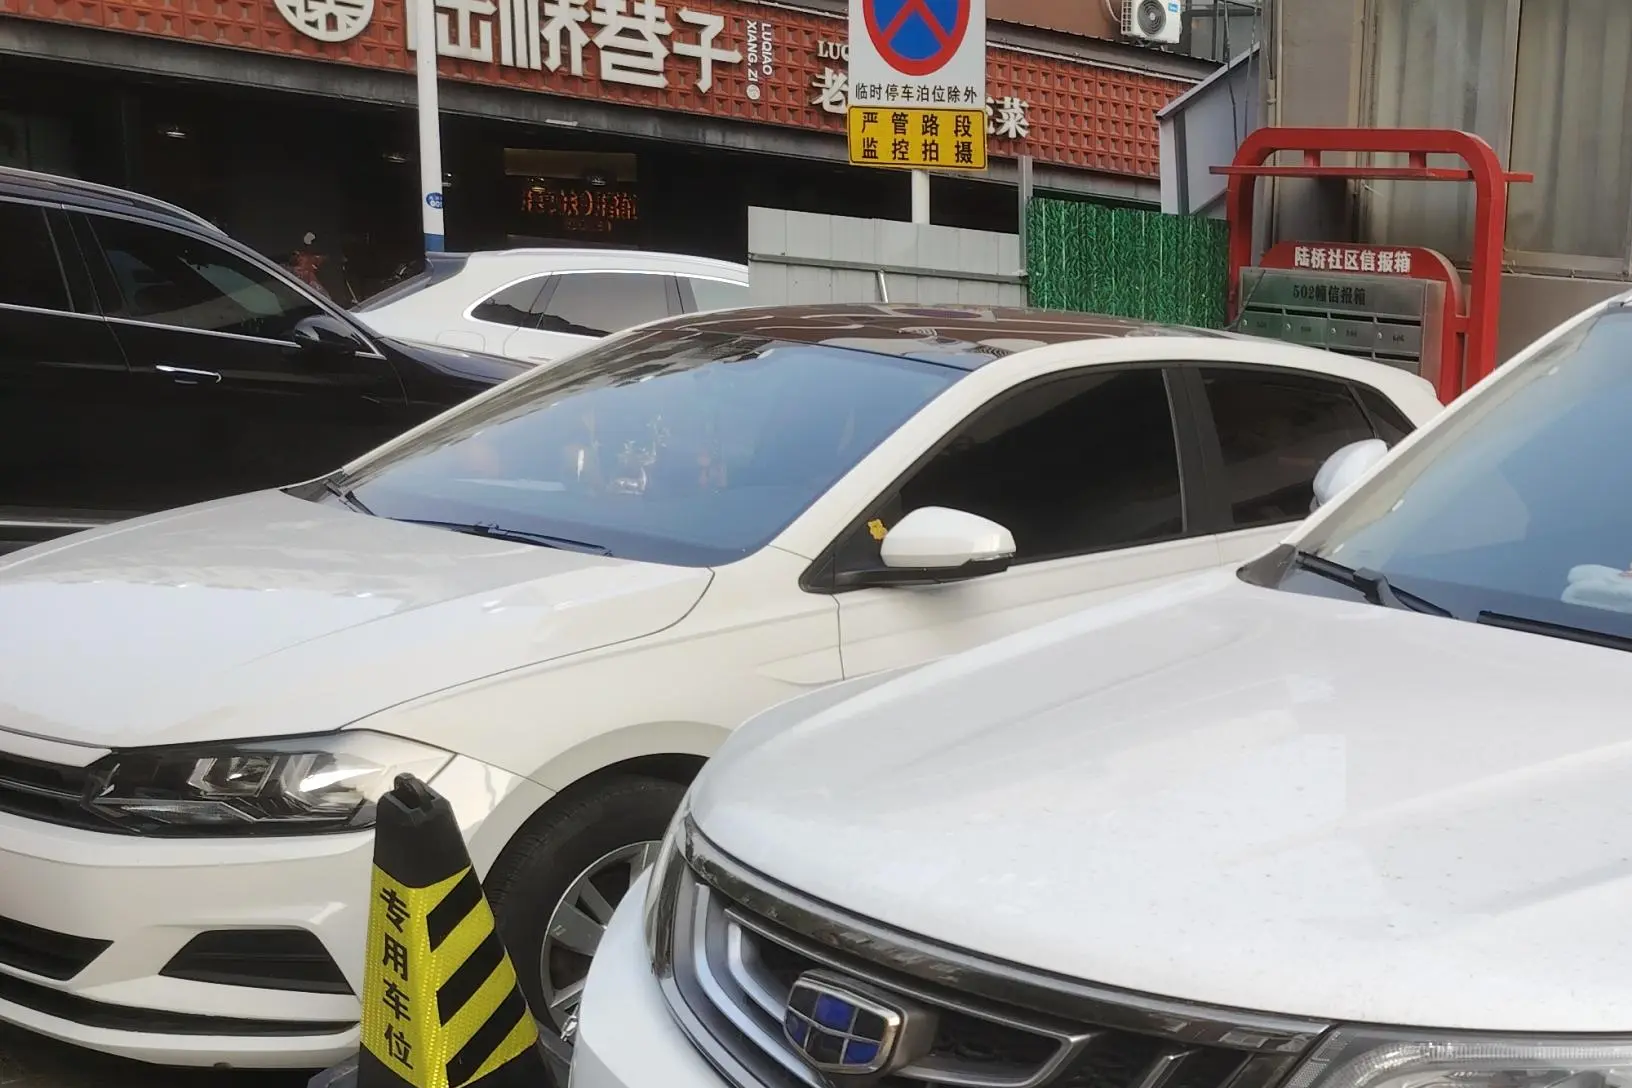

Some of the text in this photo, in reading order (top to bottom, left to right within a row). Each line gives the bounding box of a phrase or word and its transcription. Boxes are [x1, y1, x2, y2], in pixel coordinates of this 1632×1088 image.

[762, 23, 773, 76] LUQIAO
[855, 82, 978, 105] 临时停车泊位除外
[861, 111, 973, 138] 严管路段
[861, 137, 974, 164] 监控拍摄
[1294, 246, 1413, 273] 陆桥社区信报箱
[379, 887, 415, 1072] 专用车位
